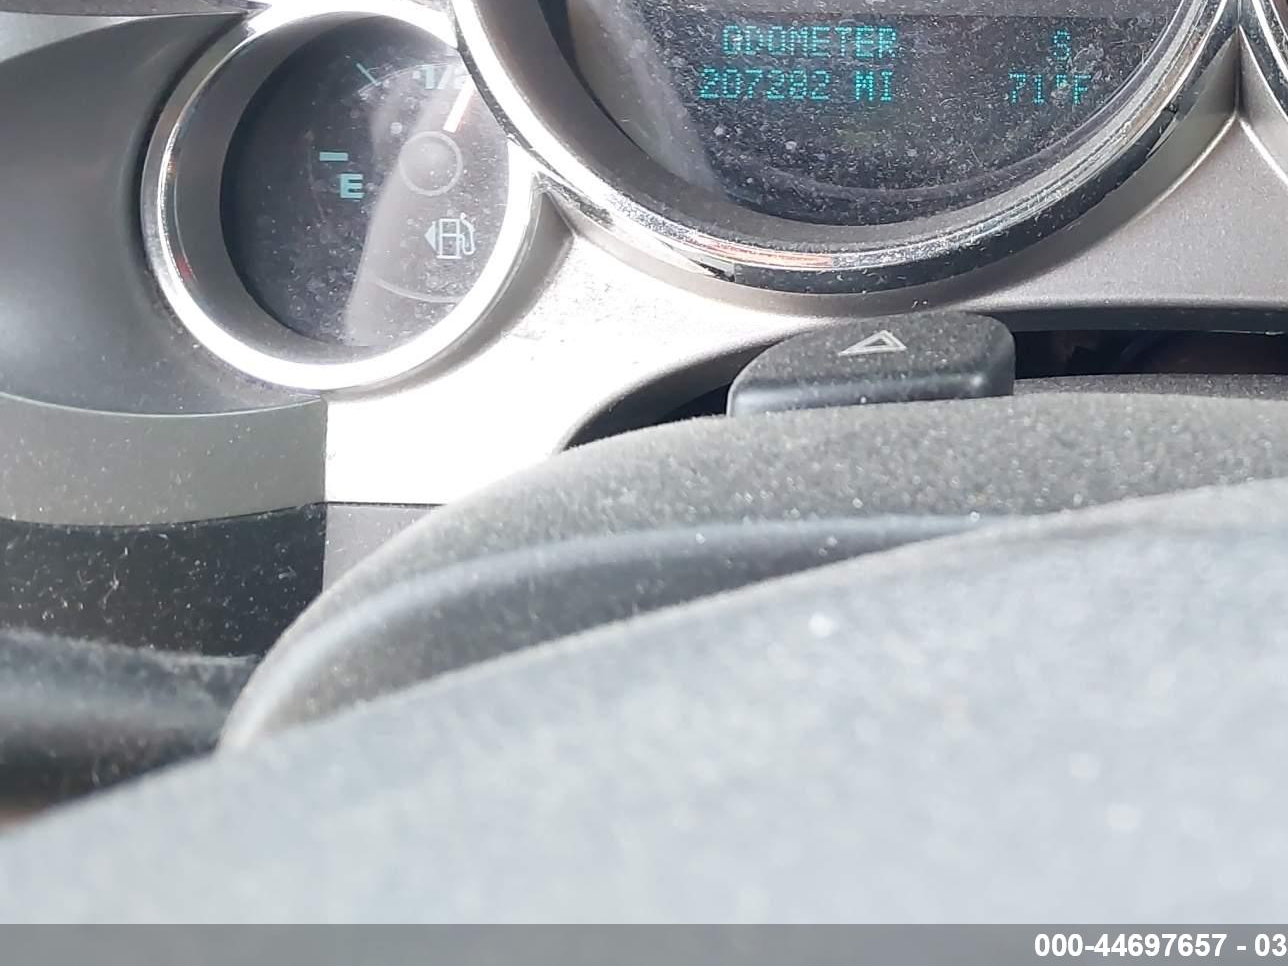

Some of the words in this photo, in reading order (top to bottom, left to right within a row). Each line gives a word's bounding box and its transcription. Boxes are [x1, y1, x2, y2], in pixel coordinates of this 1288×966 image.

[722, 25, 897, 59] ODOMETER
[699, 68, 830, 100] 207282
[855, 70, 893, 101] MI
[339, 173, 364, 199] E
